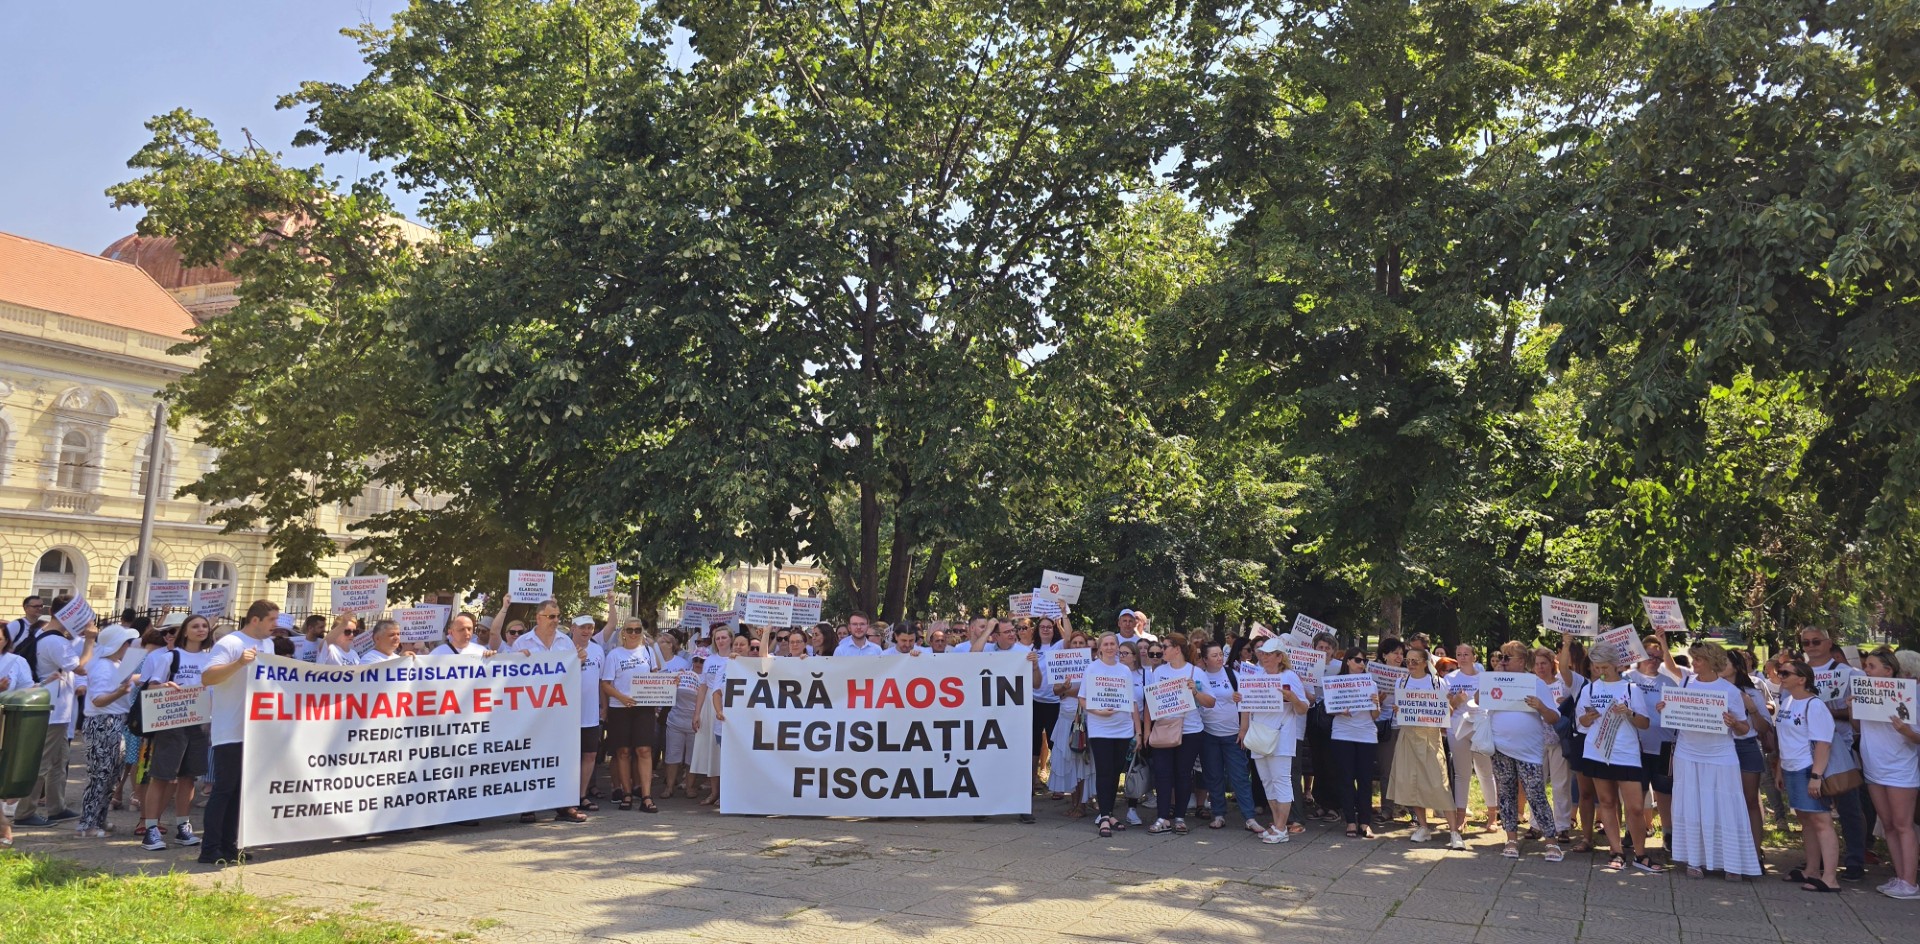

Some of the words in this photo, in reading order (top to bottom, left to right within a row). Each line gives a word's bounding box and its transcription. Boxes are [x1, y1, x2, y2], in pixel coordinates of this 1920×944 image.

[255, 664, 299, 682] FARA
[304, 670, 354, 682] HAOS
[360, 668, 379, 682] IN
[386, 666, 486, 682] LEGISLATIA
[492, 662, 566, 678] FISCALA
[1874, 680, 1895, 688] HAOS
[250, 690, 462, 721] ELIMINAREA
[473, 684, 568, 713] E-TVA
[724, 671, 832, 709] FĂRĂ
[847, 676, 964, 709] HAOS
[979, 668, 1024, 706] ÎN
[1406, 692, 1438, 700] DEFICITUL
[1664, 694, 1704, 704] ELIMINAREA
[1706, 698, 1725, 706] E-TVA
[1428, 700, 1438, 708] NU
[1440, 700, 1448, 708] SE
[348, 721, 490, 742] PREDICTIBILITATE
[752, 719, 1008, 763] LEGISLAȚIA
[308, 750, 403, 768] CONSULTARI
[408, 743, 478, 761] PUBLICE
[484, 738, 532, 754] REALE
[269, 770, 418, 794] REINTRODUCEREA
[422, 766, 464, 782] LEGII
[470, 756, 559, 776] PREVENTIEI
[793, 758, 980, 799] FISCALĂ
[272, 800, 353, 818] TERMENE
[358, 798, 378, 812] DE
[384, 786, 477, 808] RAPORTARE
[483, 777, 556, 796] REALISTE
